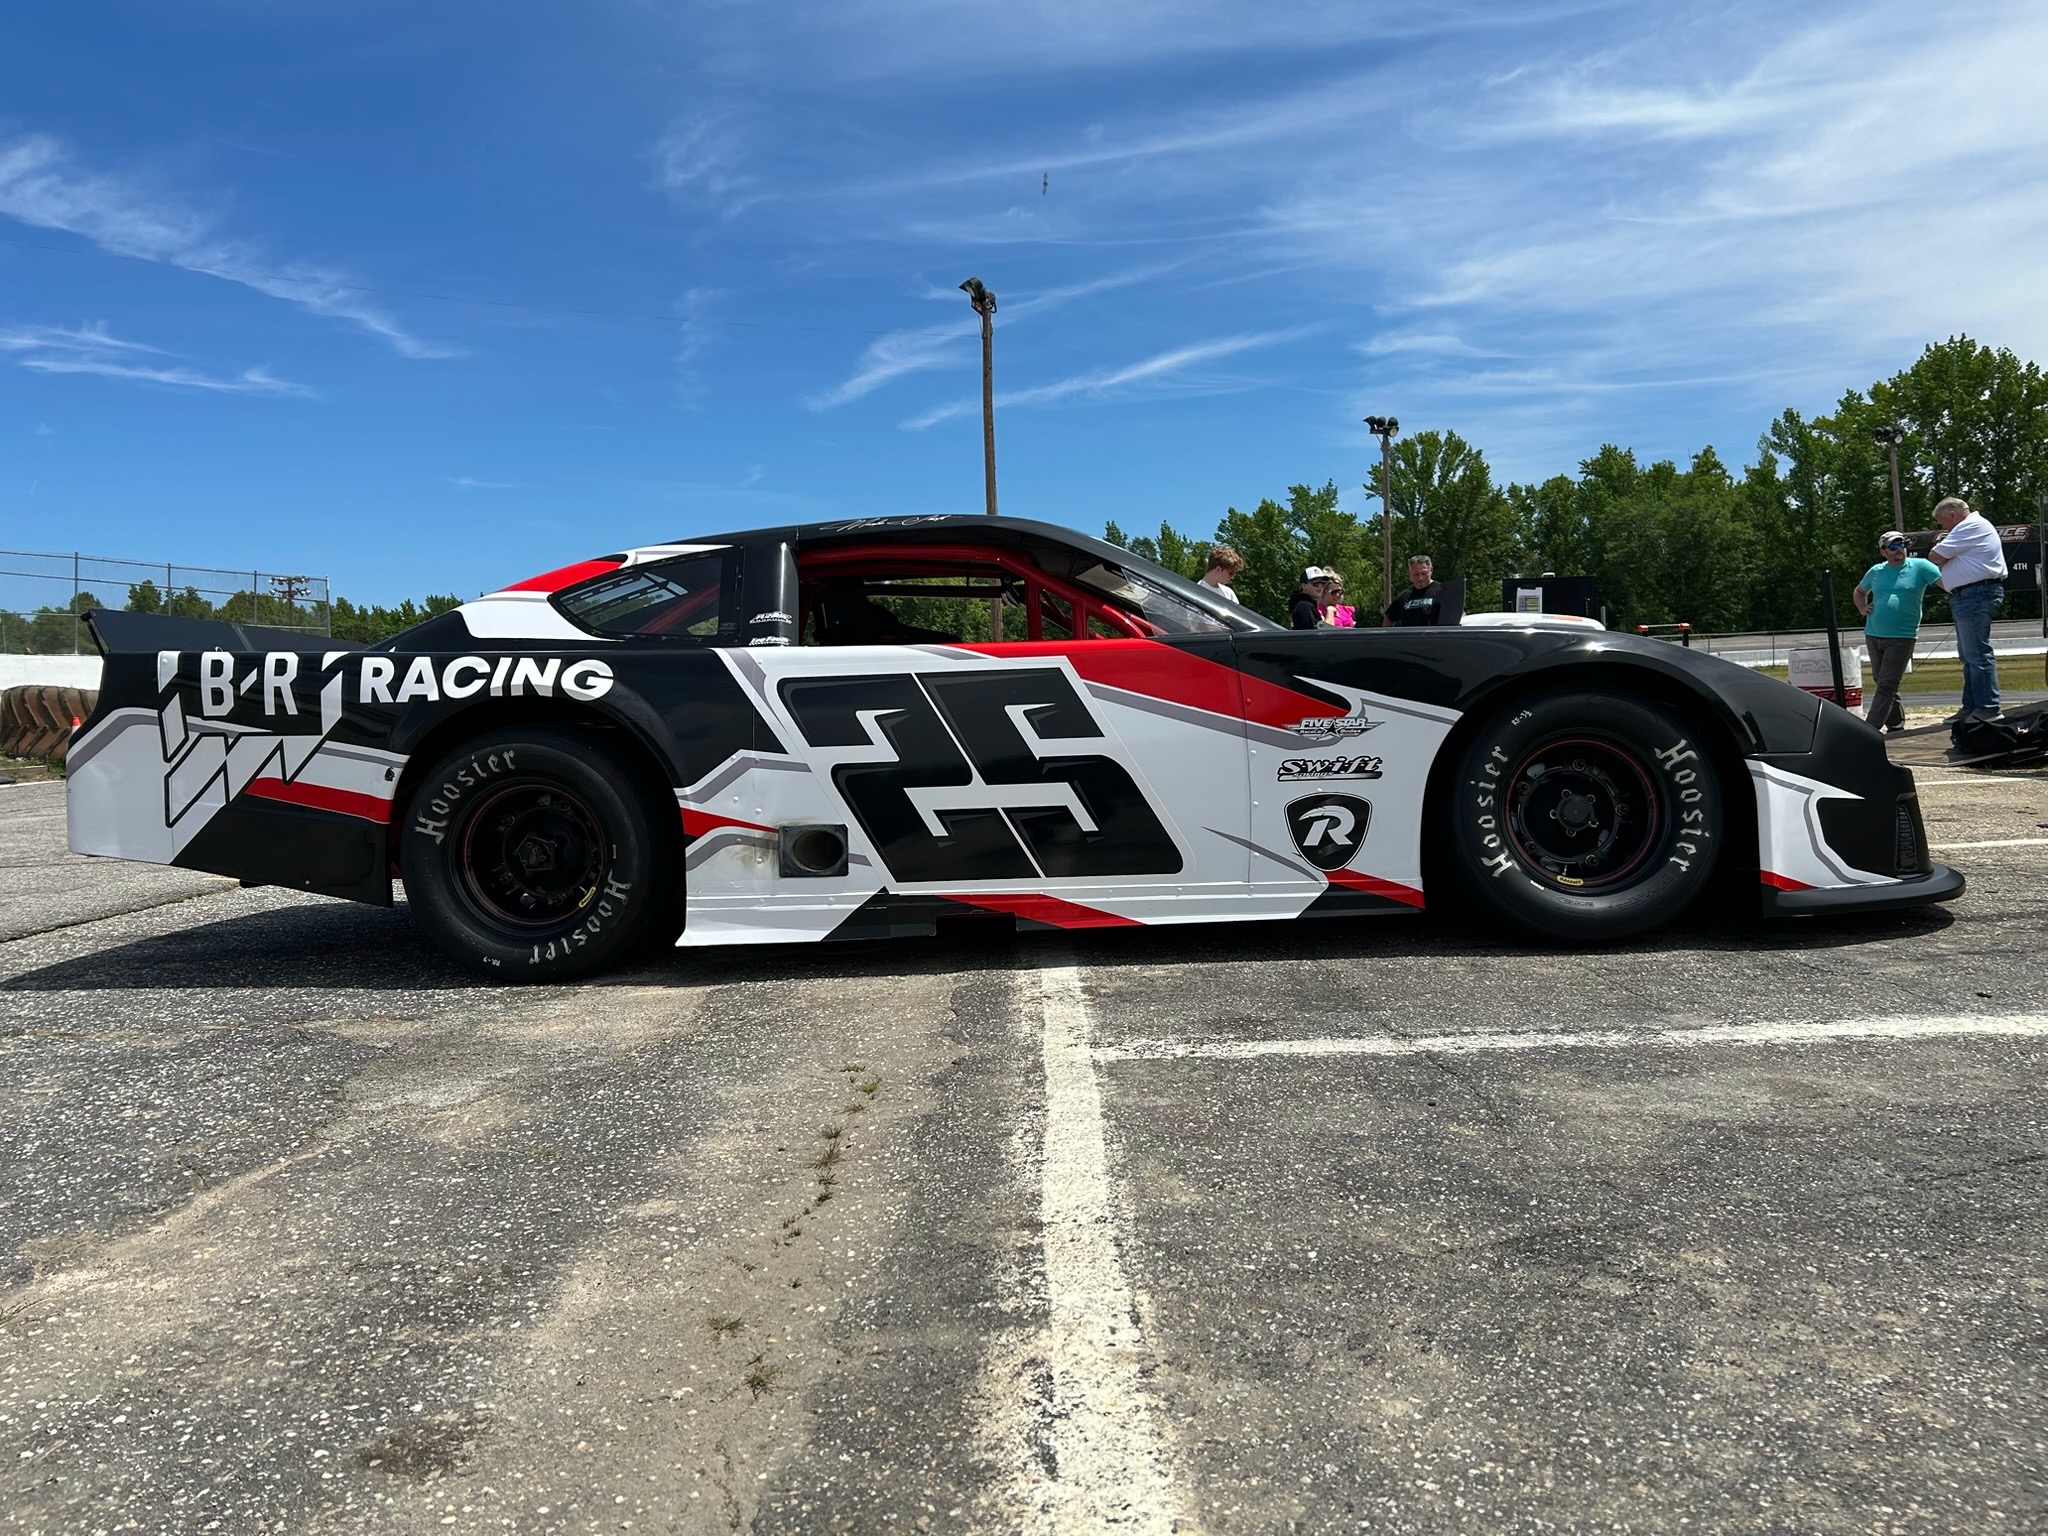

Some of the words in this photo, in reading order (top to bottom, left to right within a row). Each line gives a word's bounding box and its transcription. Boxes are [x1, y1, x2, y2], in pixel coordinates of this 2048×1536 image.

[2013, 562, 2028, 571] 4TH
[359, 655, 614, 704] RACING
[1301, 719, 1331, 728] FIVE
[1335, 718, 1367, 728] STAR
[413, 749, 517, 845] Hoosier
[1279, 756, 1382, 775] Swift
[1470, 745, 1522, 878] Hoosier
[1654, 738, 1711, 873] Hoosier
[528, 868, 633, 965] Hoosier
